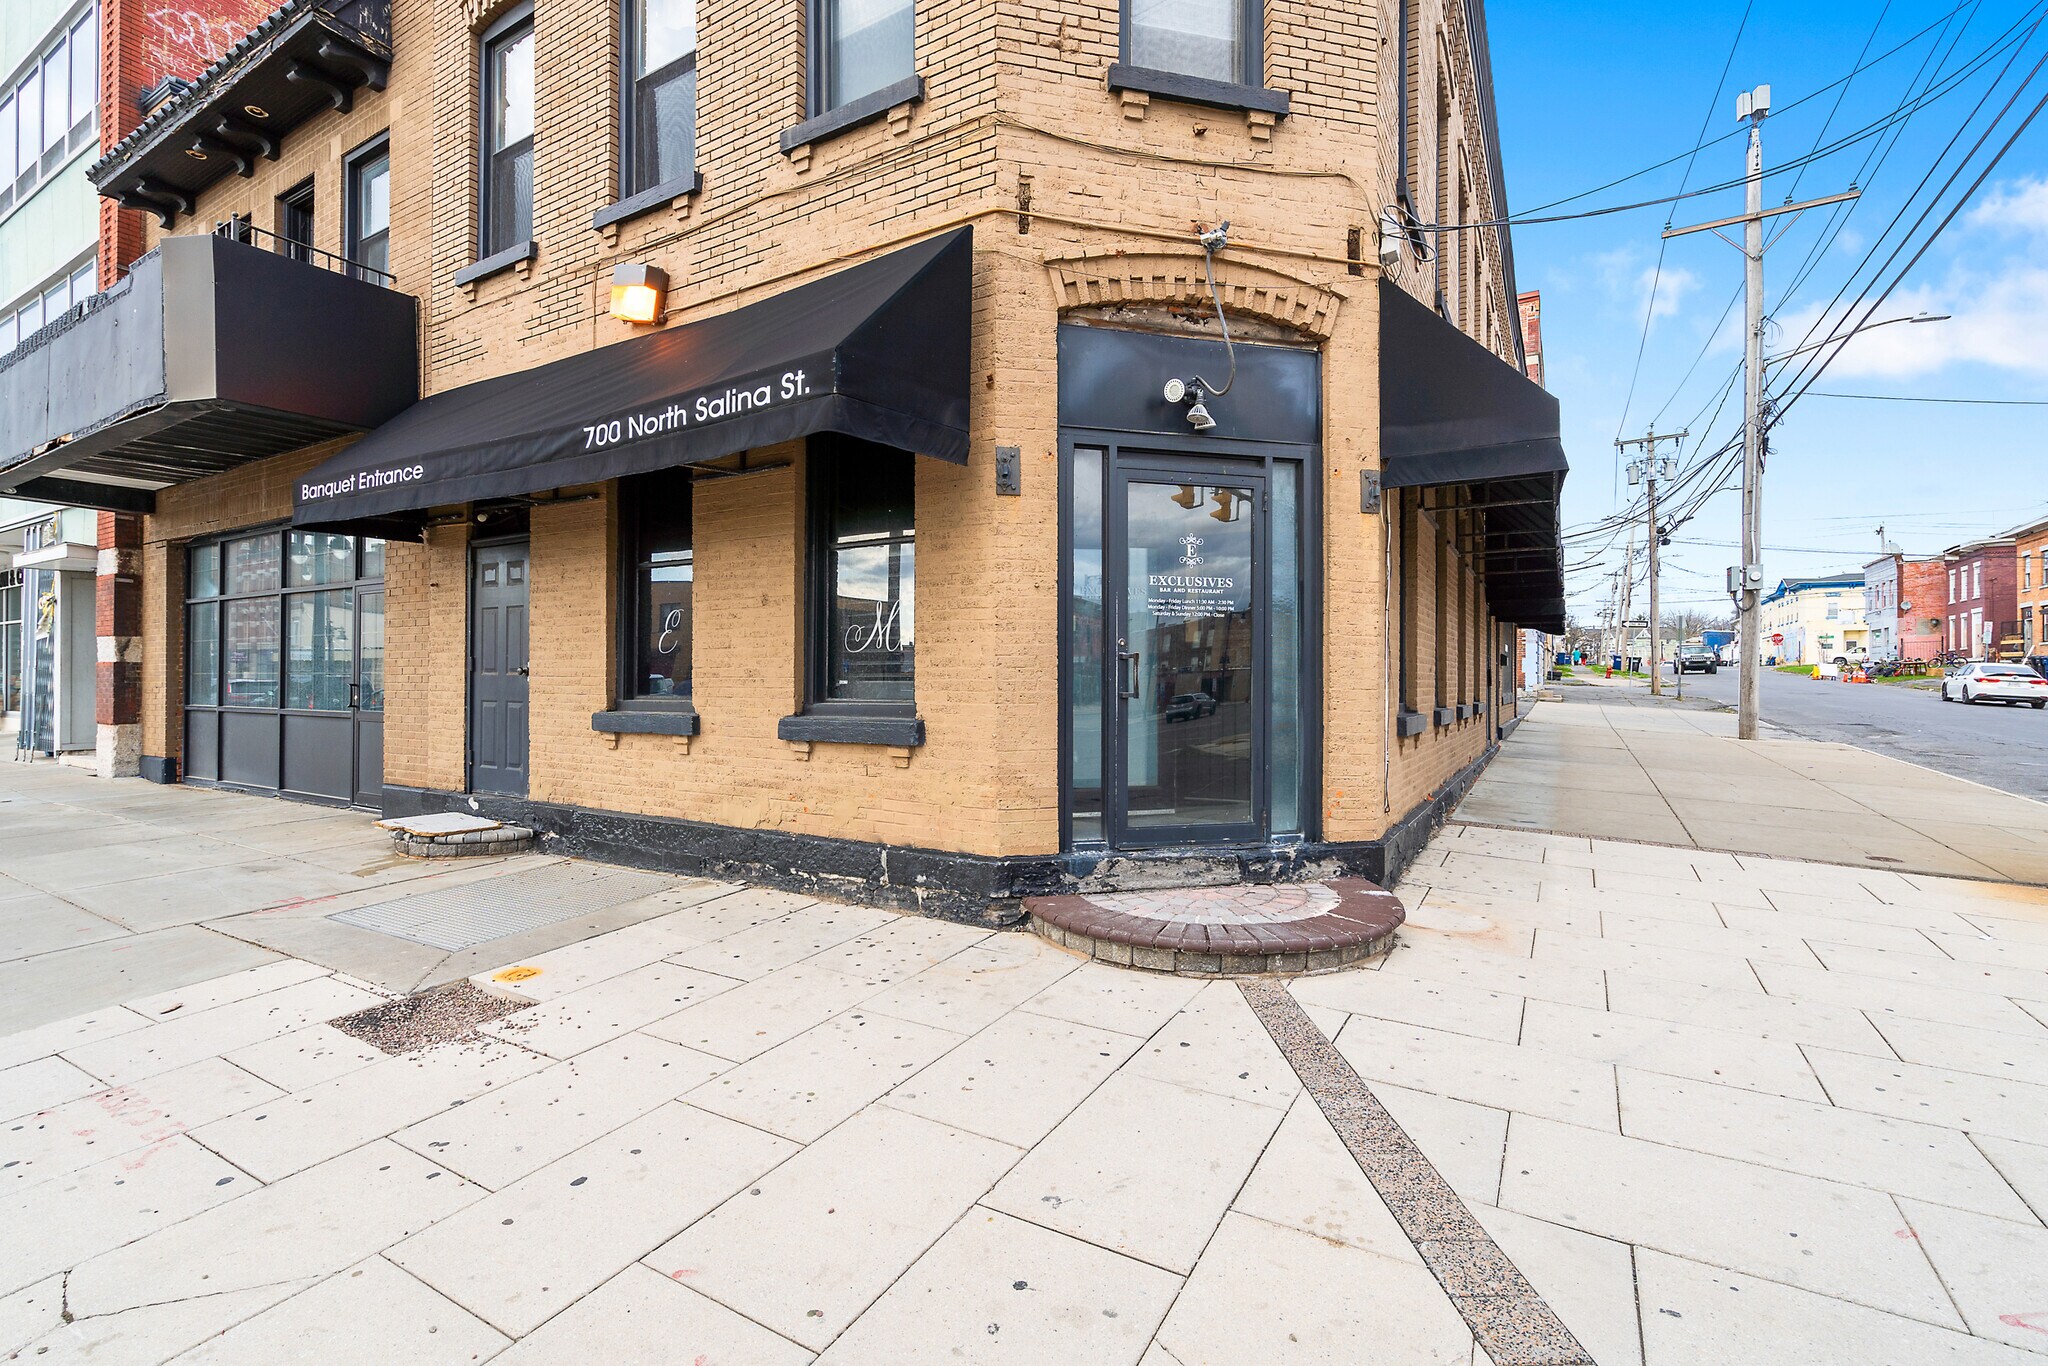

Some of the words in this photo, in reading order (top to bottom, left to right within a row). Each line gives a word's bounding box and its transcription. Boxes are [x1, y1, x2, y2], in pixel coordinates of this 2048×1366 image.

[583, 420, 621, 449] 700
[628, 404, 687, 438] North
[695, 385, 771, 421] Salina
[780, 369, 810, 400] St.
[301, 474, 355, 500] Banquet
[358, 464, 424, 490] Entrance
[1187, 544, 1197, 557] E
[1149, 575, 1233, 588] EXCLUSIVES
[658, 608, 684, 654] E
